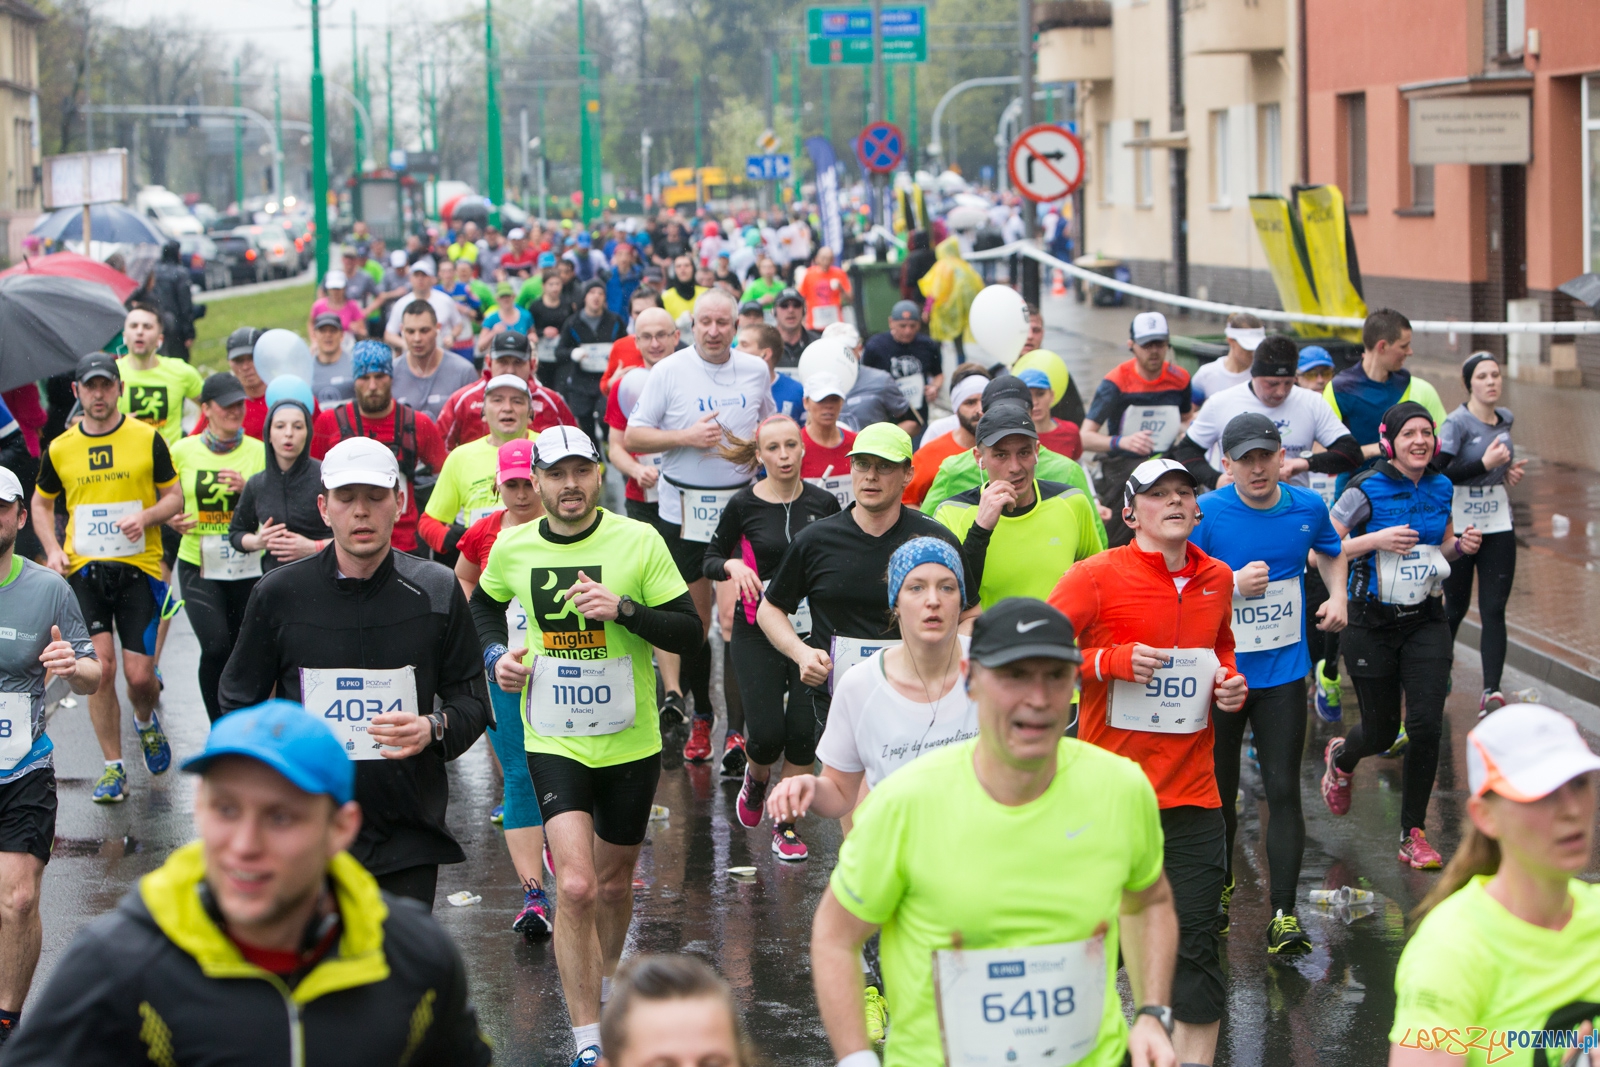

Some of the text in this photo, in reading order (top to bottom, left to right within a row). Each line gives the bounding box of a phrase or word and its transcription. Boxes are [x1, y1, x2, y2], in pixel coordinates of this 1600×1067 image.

[77, 471, 130, 486] TEATR NOWY
[1463, 500, 1499, 514] 2503
[1400, 564, 1438, 581] 5174
[1233, 600, 1294, 625] 10524
[1255, 623, 1279, 631] MARCIN
[552, 631, 595, 649] night
[545, 647, 608, 660] runners
[552, 684, 611, 705] 11100
[1145, 676, 1197, 698] 960
[324, 698, 403, 722] 4034
[571, 707, 594, 715] Maciej
[982, 986, 1076, 1023] 6418
